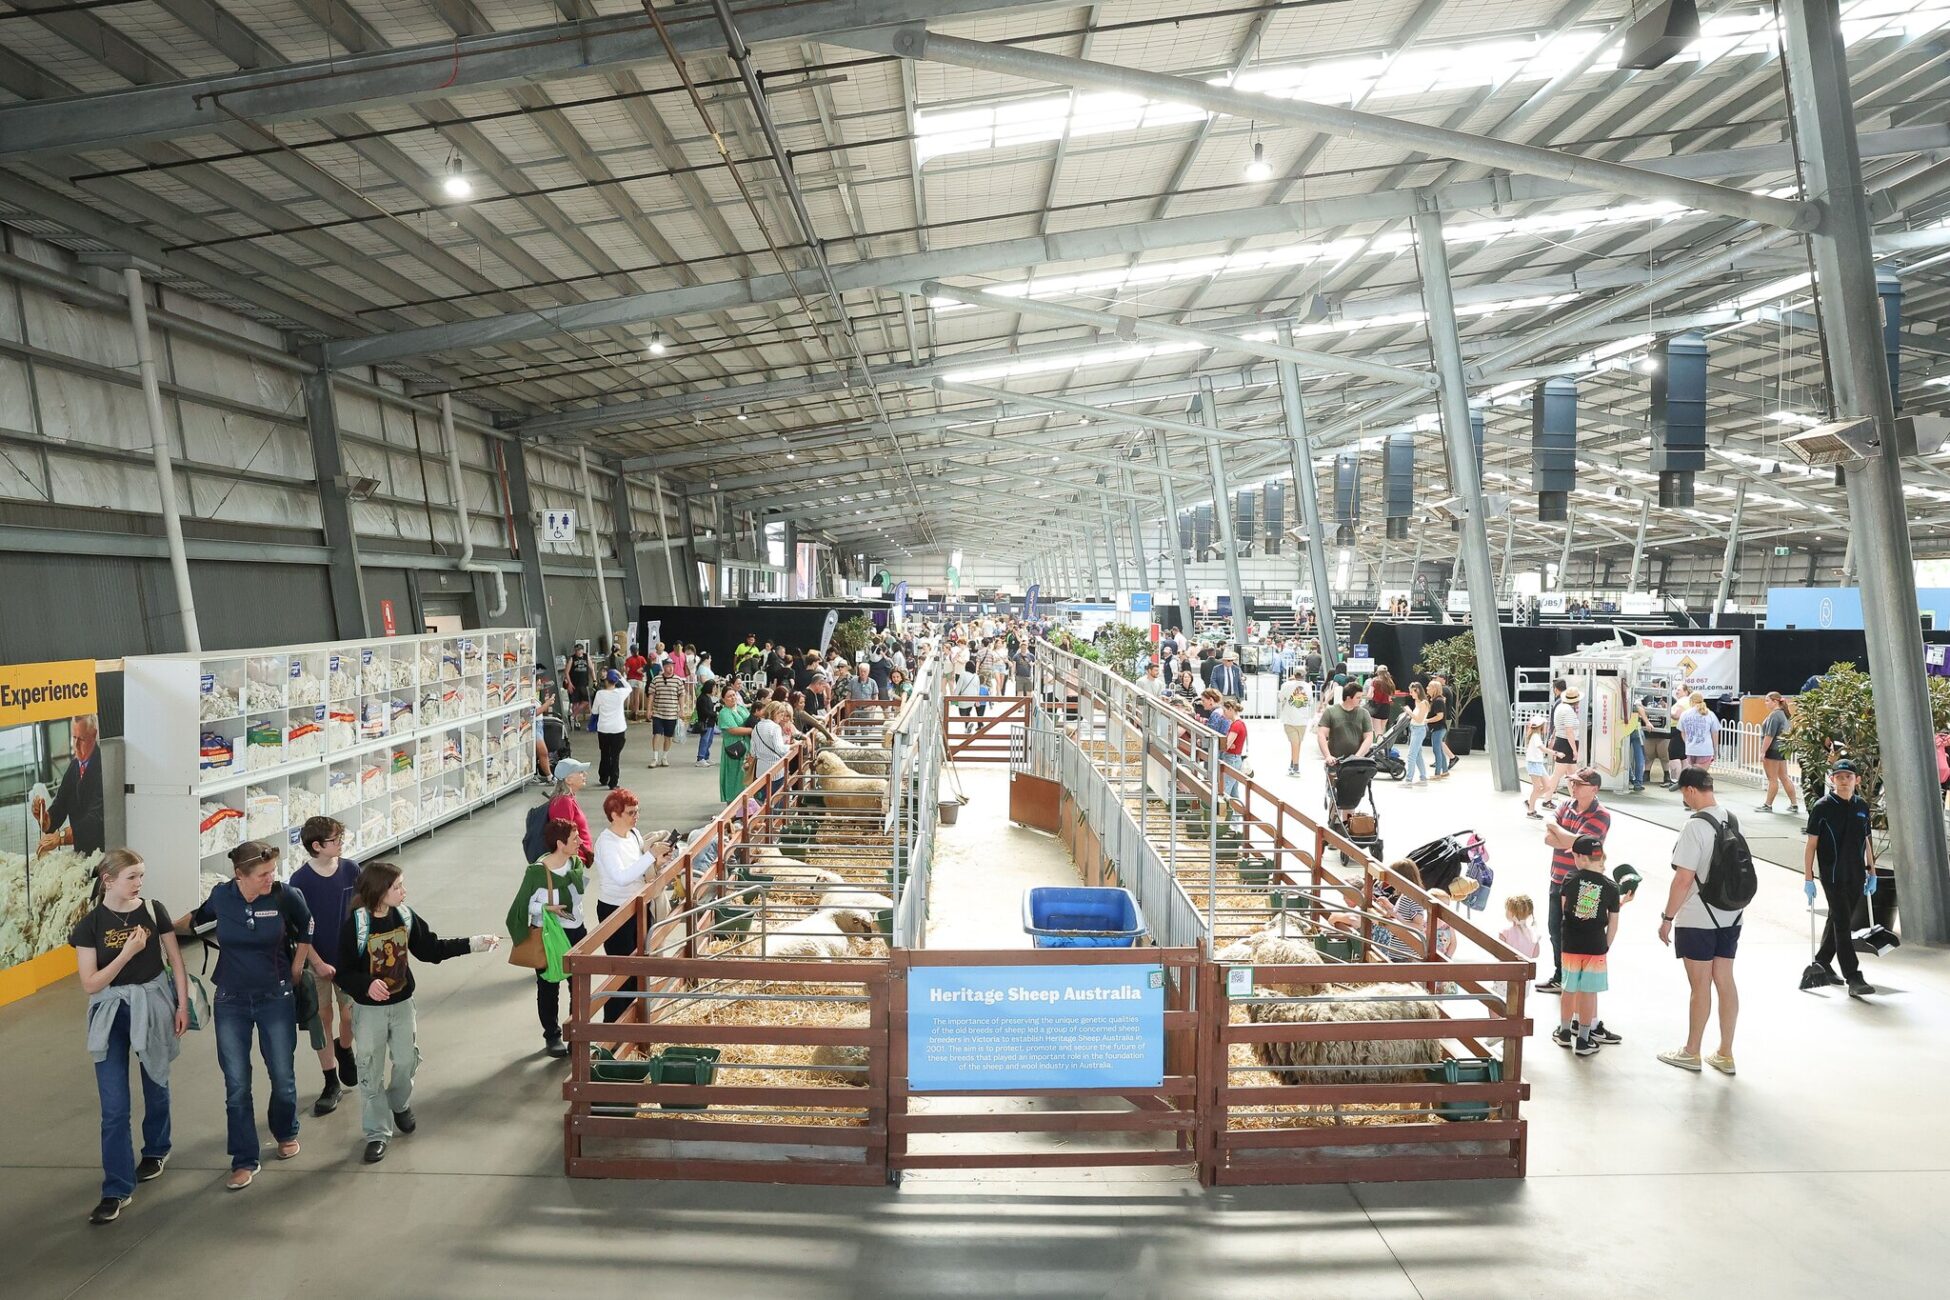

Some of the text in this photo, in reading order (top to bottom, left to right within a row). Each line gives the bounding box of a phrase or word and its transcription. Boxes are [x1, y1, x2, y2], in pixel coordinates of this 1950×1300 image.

[0, 680, 88, 710] Experience
[930, 985, 1142, 1005] Heritage Sheep Australia
[948, 1017, 990, 1026] importance
[1001, 1017, 1040, 1026] preserving
[1055, 1016, 1080, 1025] unique
[1080, 1016, 1107, 1025] genetic
[1108, 1016, 1139, 1025] qualities
[1004, 1026, 1026, 1035] sheep
[1118, 1025, 1140, 1034] sheep
[1045, 1035, 1077, 1043] Heritage
[1078, 1034, 1101, 1043] Sheep
[1026, 1044, 1057, 1052] promote
[993, 1053, 1017, 1062] played
[1029, 1053, 1066, 1061] important
[982, 1062, 1004, 1071] sheep
[1039, 1062, 1069, 1071] industry
